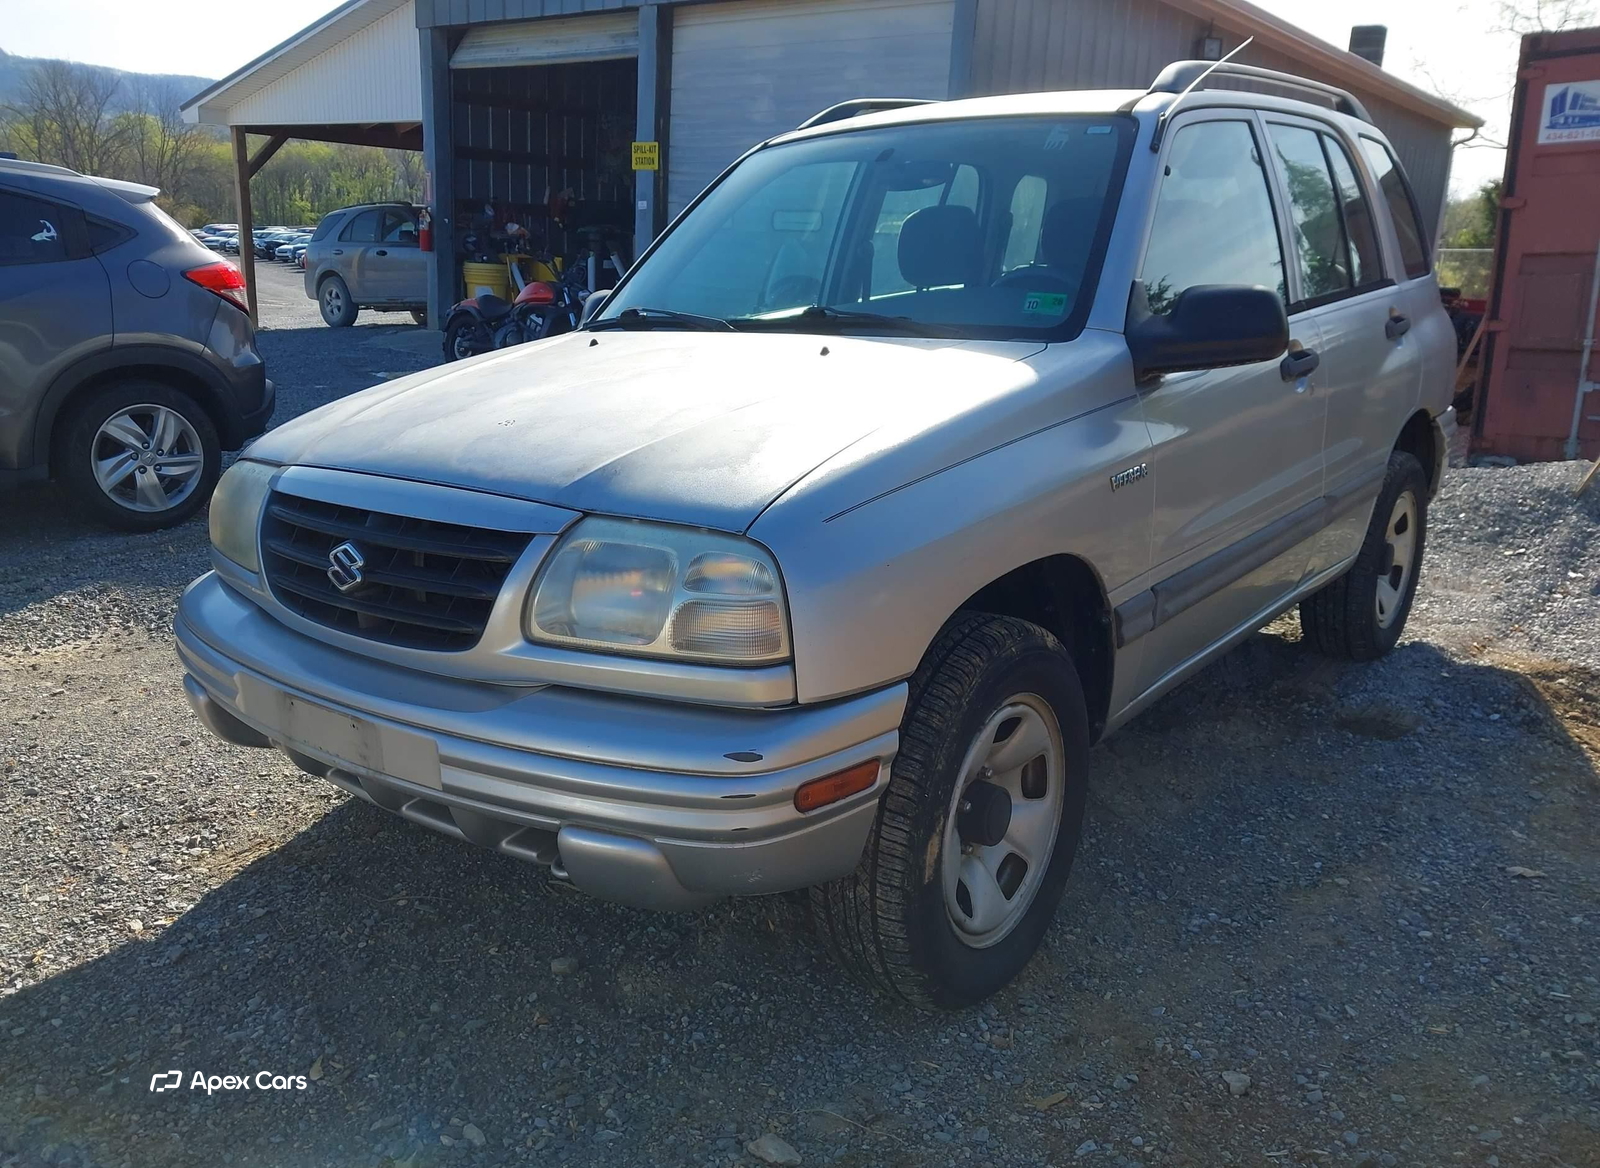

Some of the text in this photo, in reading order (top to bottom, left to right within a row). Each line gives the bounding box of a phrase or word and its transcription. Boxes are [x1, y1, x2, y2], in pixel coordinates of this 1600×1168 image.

[633, 145, 657, 154] SPILL-KIT
[634, 156, 655, 166] STATION
[1027, 300, 1039, 310] 10
